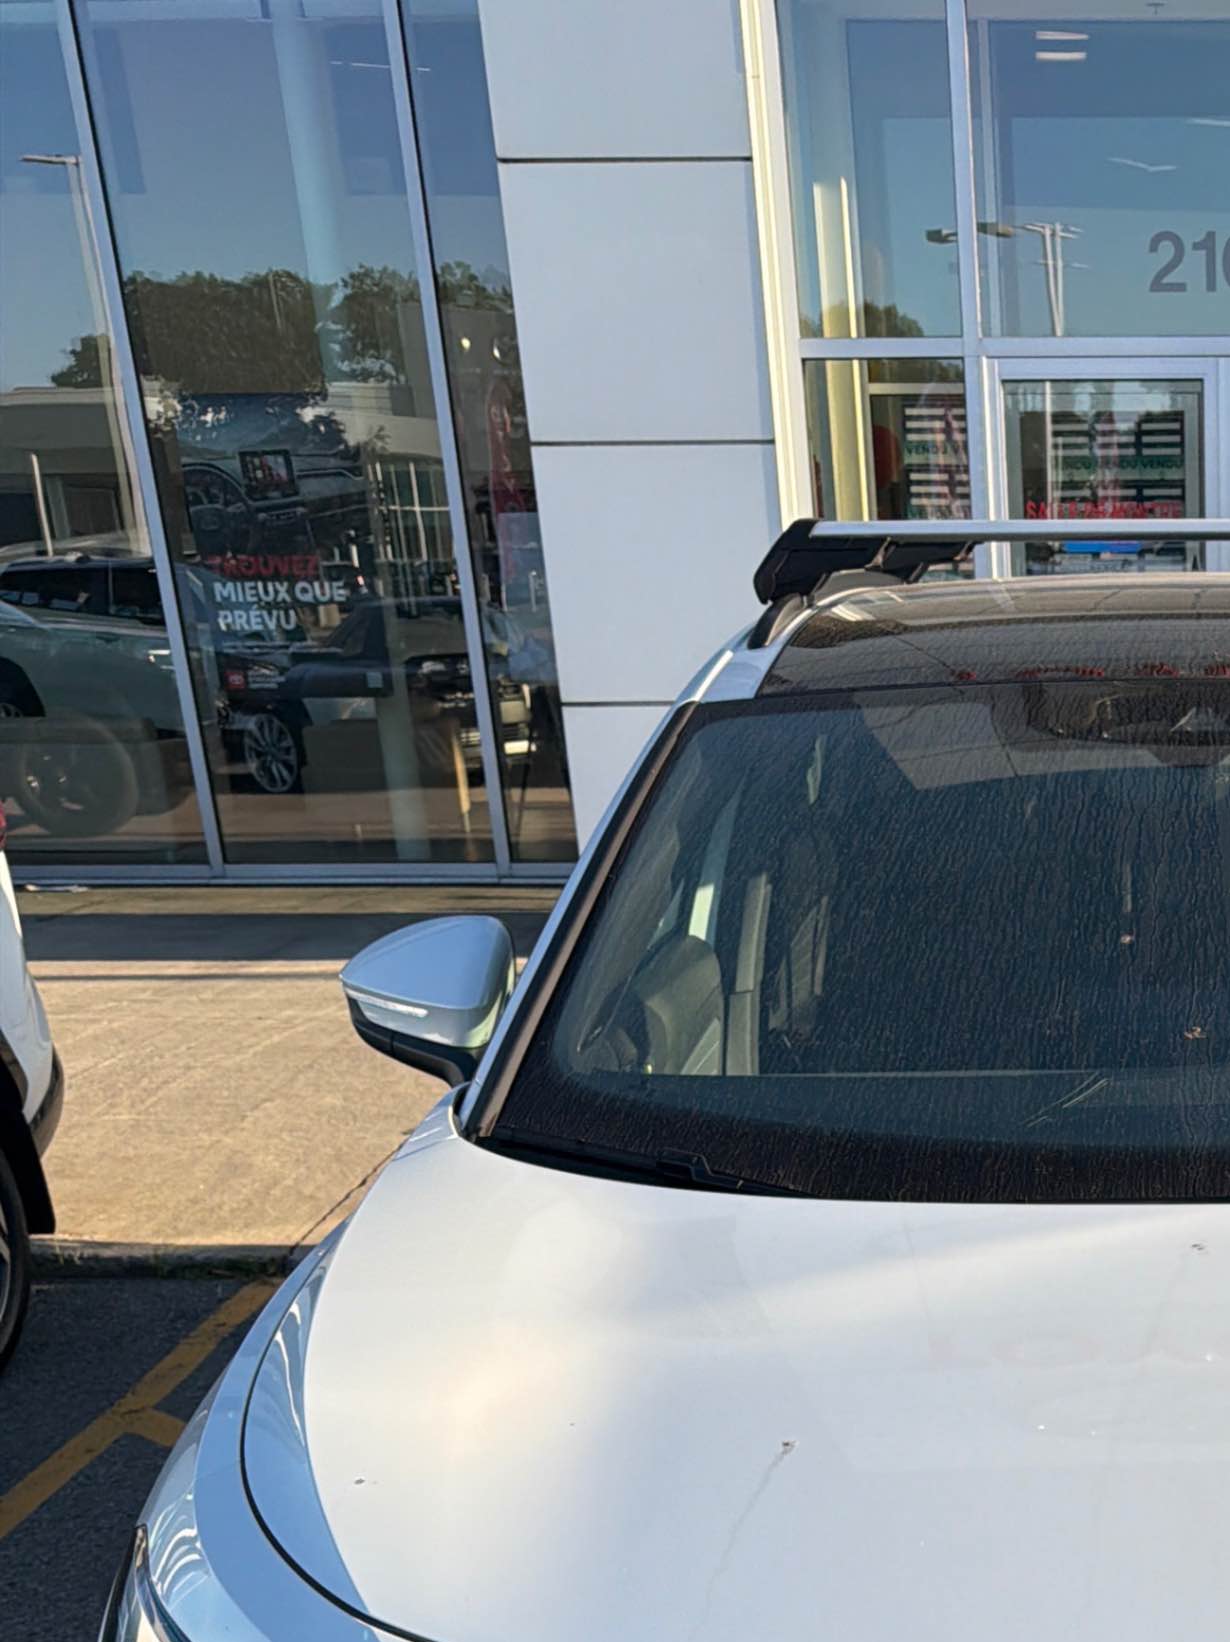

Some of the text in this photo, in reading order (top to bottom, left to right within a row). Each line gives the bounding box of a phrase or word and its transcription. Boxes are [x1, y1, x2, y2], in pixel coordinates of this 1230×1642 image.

[207, 554, 320, 577] TROUVEZ
[213, 581, 347, 603] MIEUX QUE
[218, 603, 297, 631] PRÉVU
